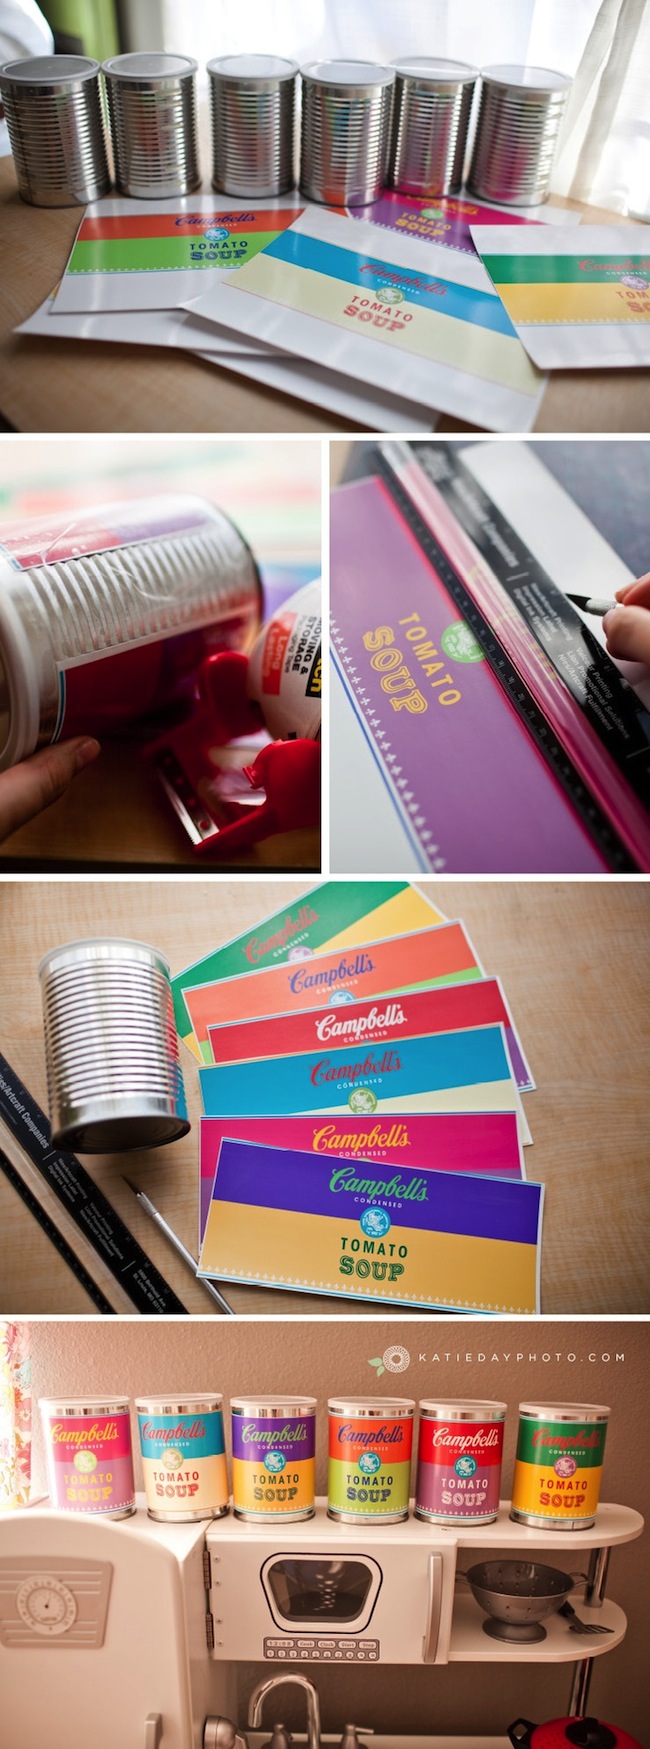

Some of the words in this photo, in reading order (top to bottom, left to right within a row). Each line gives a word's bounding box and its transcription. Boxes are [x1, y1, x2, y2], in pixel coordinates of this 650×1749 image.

[175, 212, 256, 227] Campbell's
[394, 218, 446, 236] SOUP
[401, 212, 452, 231] TOMATO
[190, 240, 248, 250] TOMATO
[190, 250, 248, 261] SOUP
[358, 262, 448, 297] Campbell's
[377, 278, 421, 295] CONDENSED
[343, 303, 406, 332] SOUP
[351, 294, 414, 323] TOMATO
[532, 615, 553, 642] Systems
[554, 614, 574, 642] Printing
[271, 635, 289, 671] Long
[292, 616, 317, 672] STORAGE
[362, 626, 428, 714] SOUP
[398, 612, 462, 706] TOMATO
[300, 665, 308, 676] &
[558, 654, 588, 696] Nies/Artcraft
[585, 694, 614, 732] Fulfillment
[566, 650, 579, 668] Lion
[576, 666, 609, 712] Promotional
[604, 704, 631, 740] Solutions
[592, 671, 613, 699] Printing
[242, 904, 320, 964] Campbell's
[272, 932, 310, 958] CONDENSED
[288, 954, 376, 994] Campbell's
[315, 979, 359, 995] CONDENSED
[315, 1004, 408, 1041] Campbell's
[343, 1030, 388, 1043] CONDENSED
[310, 1050, 402, 1087] Campbell's
[336, 1078, 383, 1090] CONDENSED
[21, 1112, 50, 1149] Companies
[312, 1124, 412, 1152] Campbell's
[328, 1166, 429, 1202] Campbell's
[354, 1196, 402, 1208] CONDENSED
[340, 1236, 408, 1258] TOMATO
[339, 1255, 405, 1282] SOUP
[50, 1422, 120, 1444] Campbell's
[141, 1420, 207, 1442] Campbell's
[242, 1424, 308, 1444] Campbell's
[337, 1424, 404, 1446] Campbell's
[432, 1428, 499, 1450] Campbell's
[532, 1427, 600, 1451] Campbell's
[64, 1472, 113, 1486] TOMATO
[153, 1471, 200, 1482] TOMATO
[252, 1473, 300, 1485] TOMATO
[346, 1474, 394, 1486] TOMATO
[441, 1478, 488, 1489] TOMATO
[539, 1478, 588, 1491] TOMATO
[66, 1484, 114, 1502] SOUP
[155, 1482, 200, 1499] SOUP
[253, 1486, 298, 1502] SOUP
[346, 1486, 392, 1503] SOUP
[441, 1490, 487, 1508] SOUP
[539, 1492, 586, 1508] SOUP
